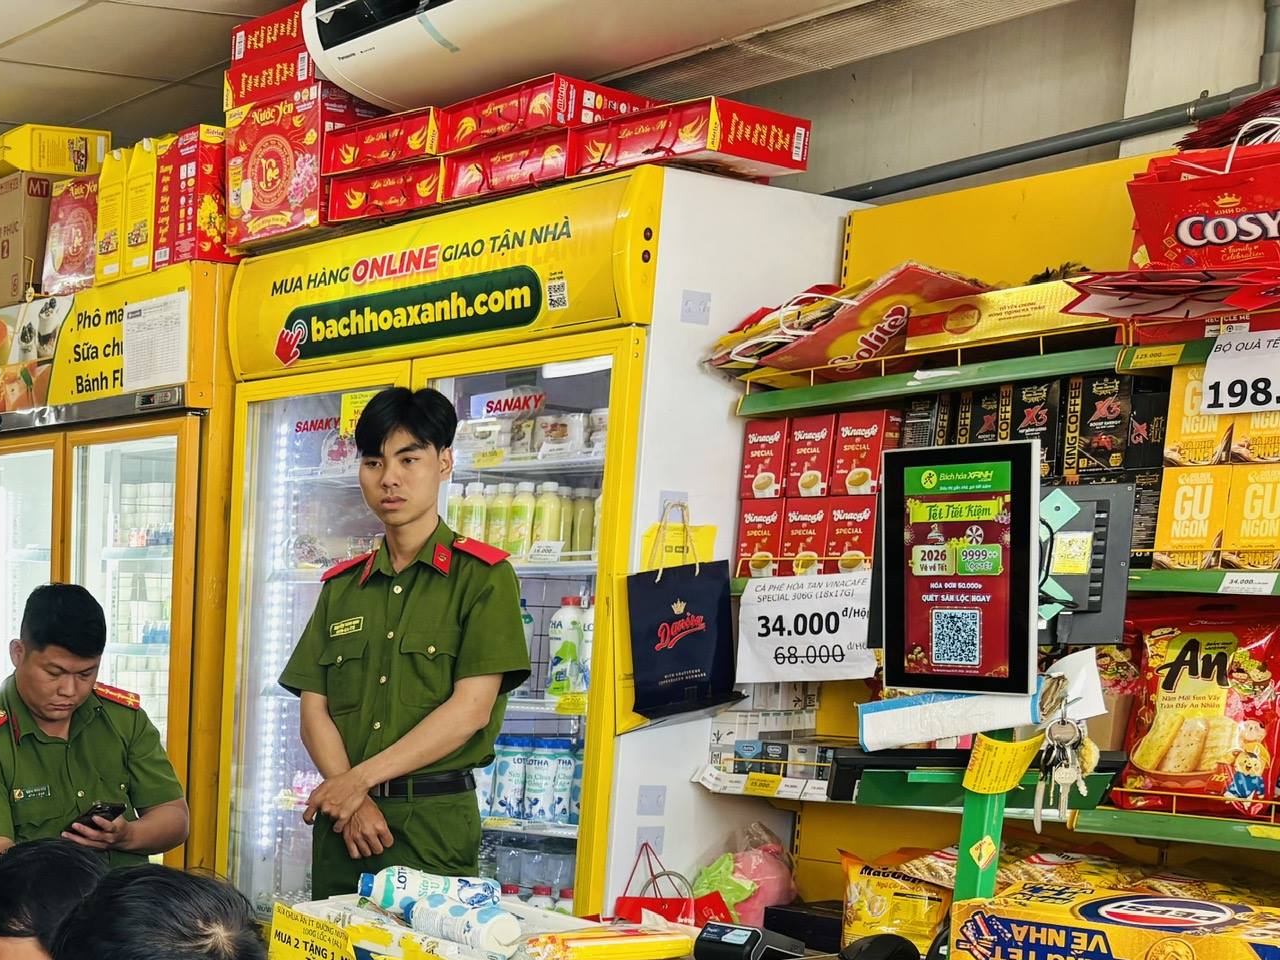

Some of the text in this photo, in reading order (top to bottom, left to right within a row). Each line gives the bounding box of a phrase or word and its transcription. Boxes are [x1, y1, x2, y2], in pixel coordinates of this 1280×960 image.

[1177, 211, 1280, 247] COSY
[271, 216, 572, 297] MUA HÀNG ONLINE GIAO TẬN NHÀ
[77, 311, 101, 330] Phô
[311, 284, 531, 342] bachhoaxanh.com
[74, 343, 99, 362] Sữa
[1214, 342, 1231, 353] BỘ
[1235, 339, 1262, 352] QUẢ
[76, 375, 109, 394] Bánh
[486, 395, 543, 415] SANAKY
[1067, 381, 1081, 435] COFFEE
[750, 449, 774, 458] SPECIAL
[797, 446, 820, 454] SPECIAL
[843, 442, 870, 451] SPECIAL
[1173, 485, 1213, 520] GU
[1171, 520, 1210, 538] NGON
[921, 550, 946, 561] 2026
[962, 550, 988, 560] 9999
[808, 580, 822, 590] TAN
[758, 592, 789, 603] SPECIAL
[792, 591, 812, 601] 306G
[758, 611, 840, 638] 34.000
[774, 644, 844, 665] 68.000
[1156, 638, 1230, 692] An
[274, 930, 291, 946] MUA
[294, 938, 299, 949] 2
[303, 940, 327, 959] TẶNG
[1011, 924, 1108, 958] VỀ NHÀ
